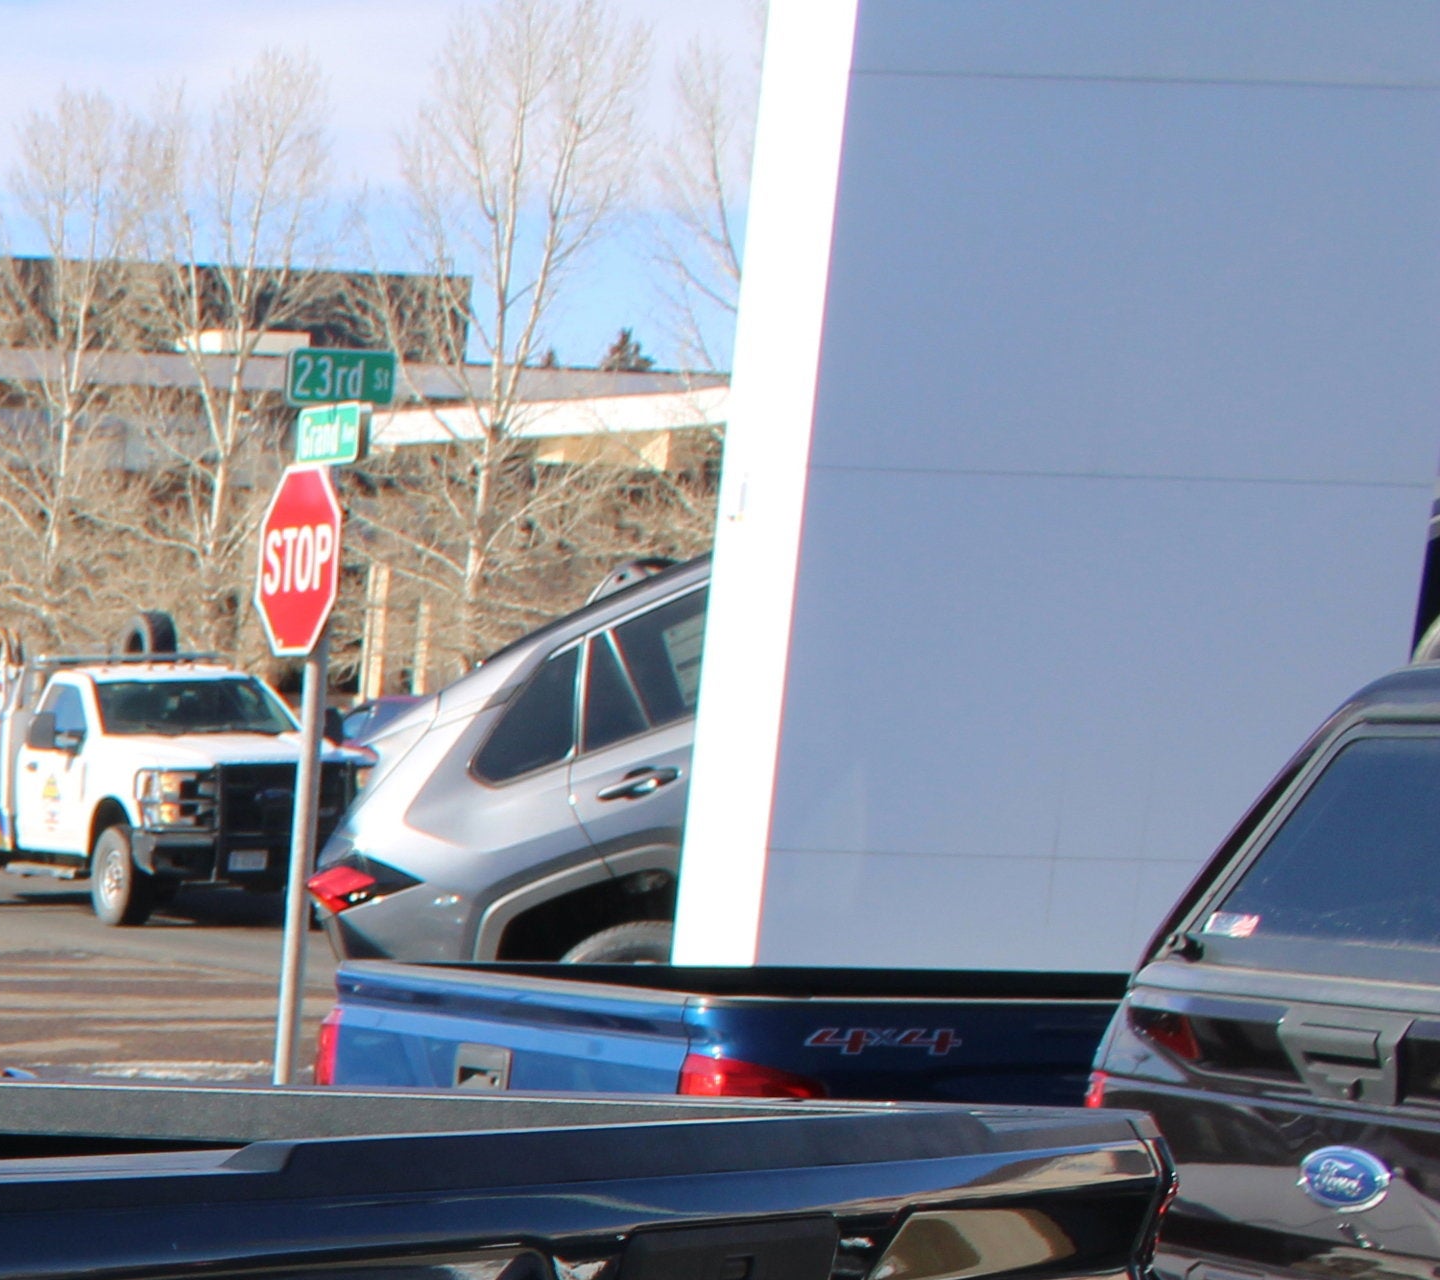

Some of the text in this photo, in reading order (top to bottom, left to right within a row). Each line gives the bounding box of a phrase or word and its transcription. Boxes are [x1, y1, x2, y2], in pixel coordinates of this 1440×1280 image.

[294, 355, 391, 398] 23rd St
[299, 415, 341, 459] Grand
[262, 523, 332, 596] STOP
[1313, 1157, 1366, 1199] Ford
